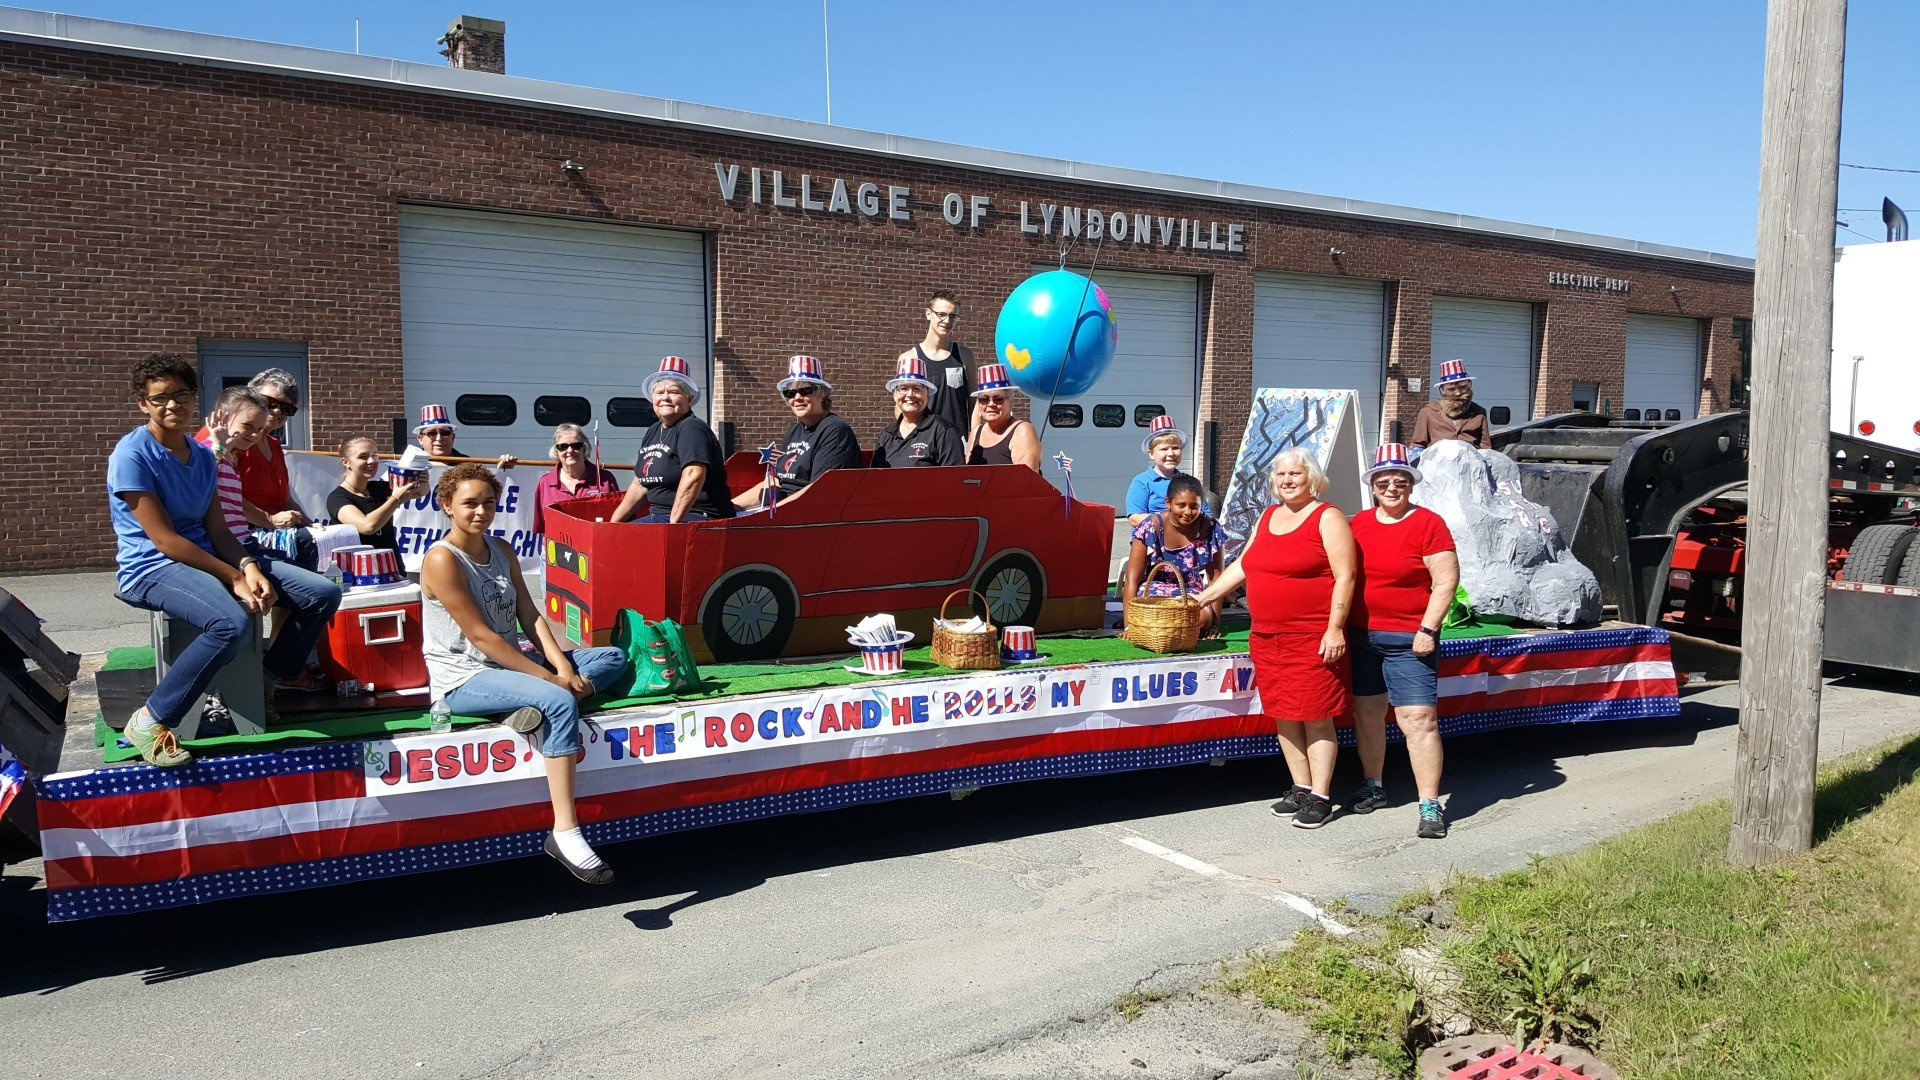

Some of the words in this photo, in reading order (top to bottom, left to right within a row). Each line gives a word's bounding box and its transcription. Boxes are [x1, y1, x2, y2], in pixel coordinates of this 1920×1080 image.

[715, 163, 909, 219] VILLAGE
[943, 193, 989, 227] OF
[1021, 201, 1244, 251] LYNDONVILLE
[1549, 272, 1599, 288] ELECTRIC
[1606, 279, 1629, 291] DEPT
[380, 740, 516, 785] JESUS
[604, 723, 676, 760] THE
[704, 707, 805, 747] ROCK
[819, 700, 882, 733] AND
[892, 696, 929, 726] HE
[944, 685, 1037, 720] ROLLS
[1052, 680, 1086, 708] MY
[1112, 672, 1198, 703] BLUES
[1220, 667, 1259, 693] AWA
